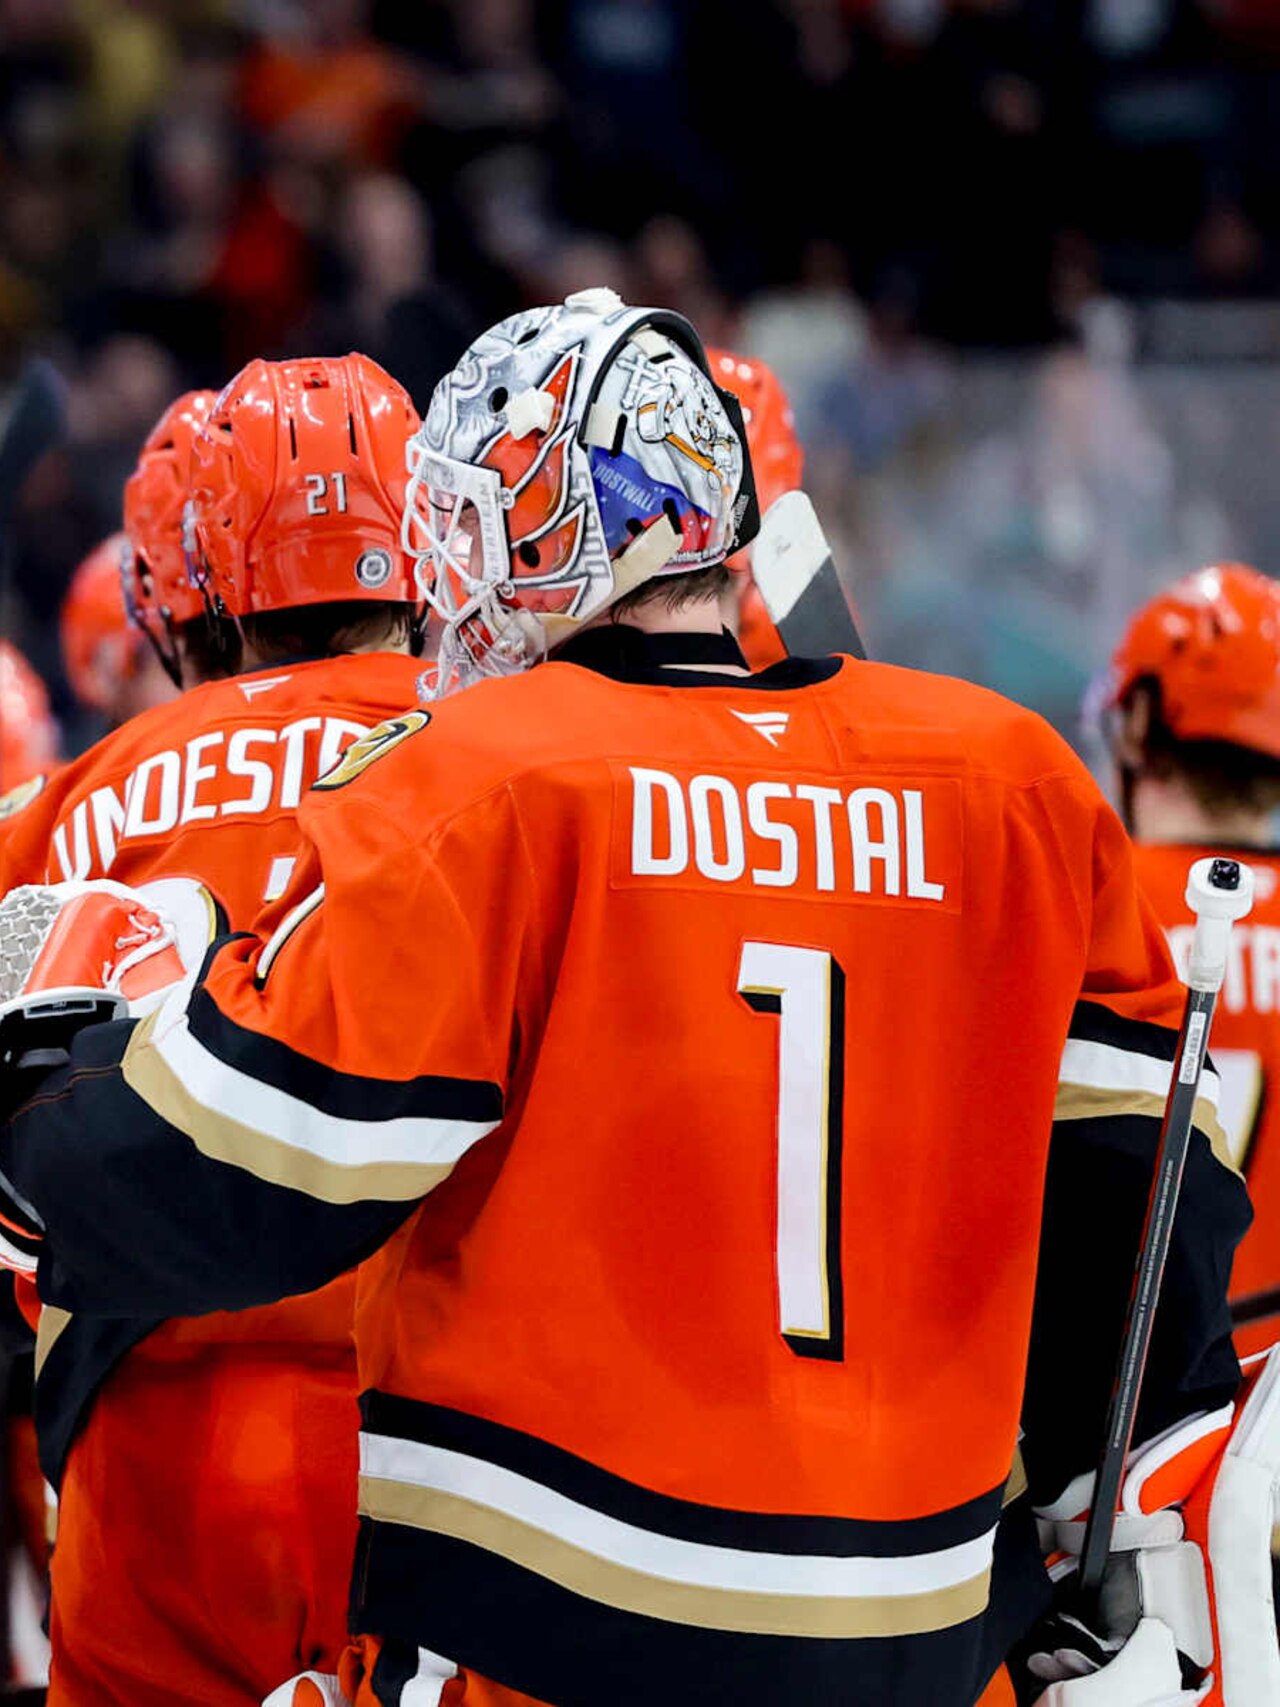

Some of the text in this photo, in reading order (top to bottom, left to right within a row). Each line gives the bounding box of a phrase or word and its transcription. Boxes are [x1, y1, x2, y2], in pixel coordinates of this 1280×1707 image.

[304, 472, 349, 516] 21
[628, 766, 945, 901] DOSTAL
[736, 940, 847, 1363] 1
